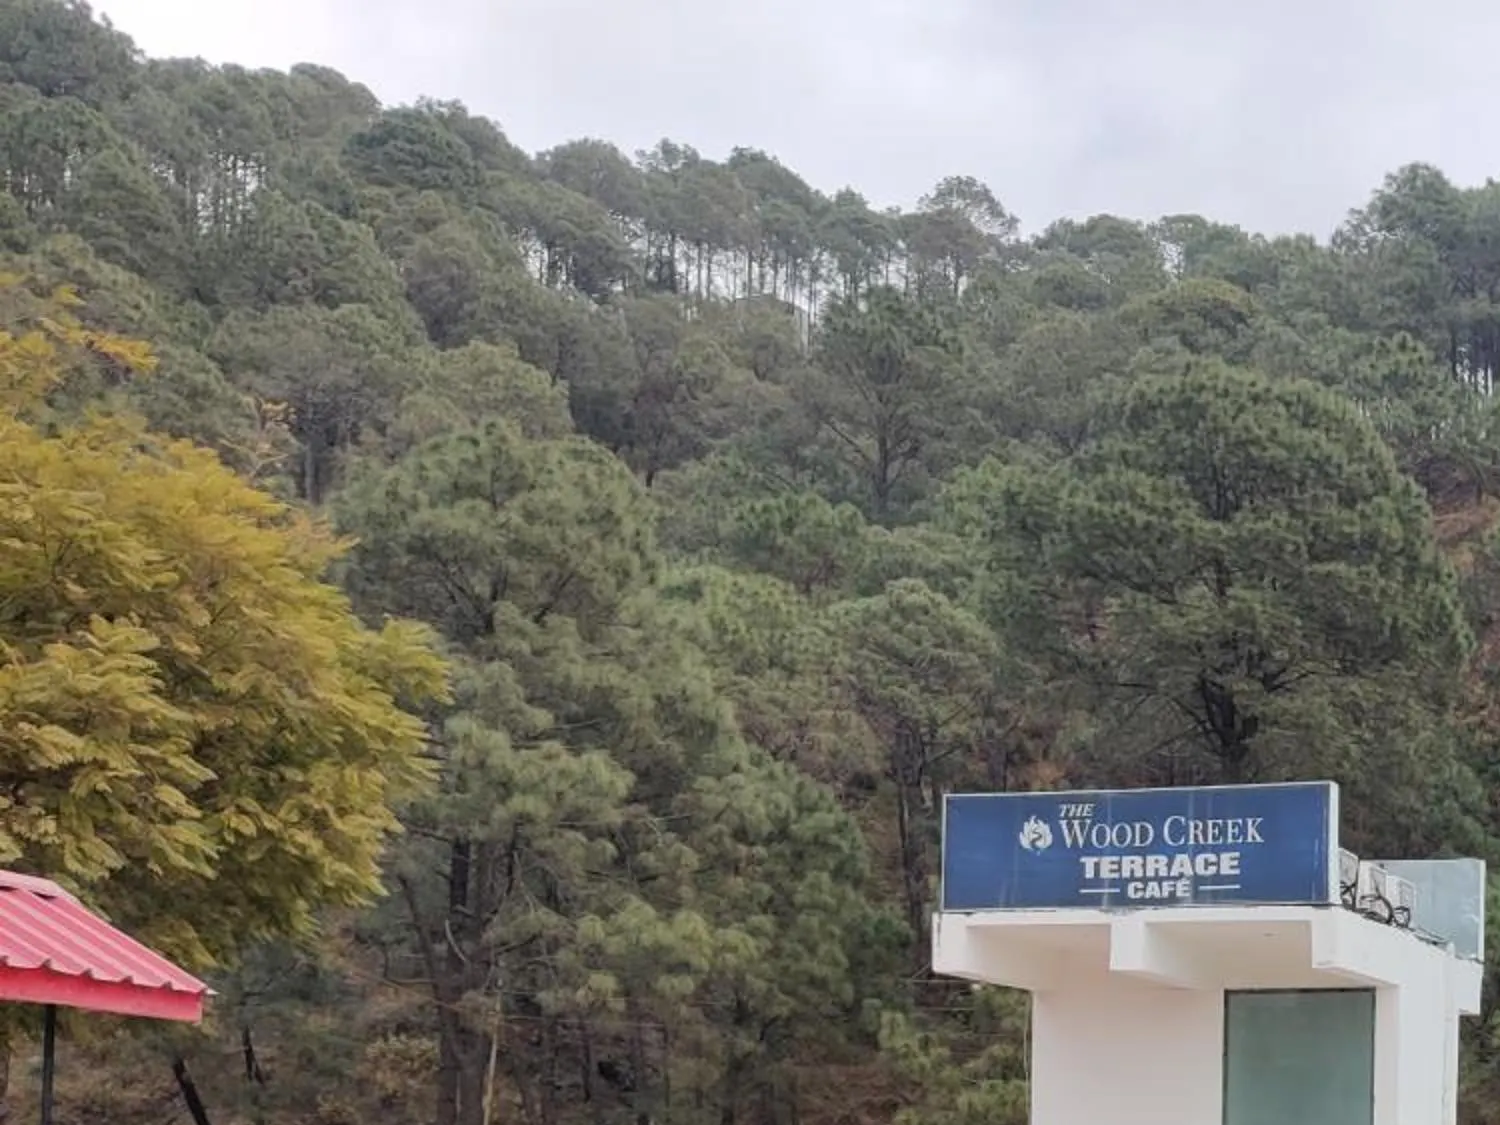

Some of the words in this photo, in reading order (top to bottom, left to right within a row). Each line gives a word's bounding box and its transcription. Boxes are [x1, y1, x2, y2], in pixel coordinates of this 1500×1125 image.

[1059, 803, 1095, 817] THE
[1059, 818, 1154, 848] WOOD
[1163, 815, 1264, 847] CREEK
[1080, 852, 1241, 879] TERRACE
[1127, 878, 1191, 899] CAFÉ
